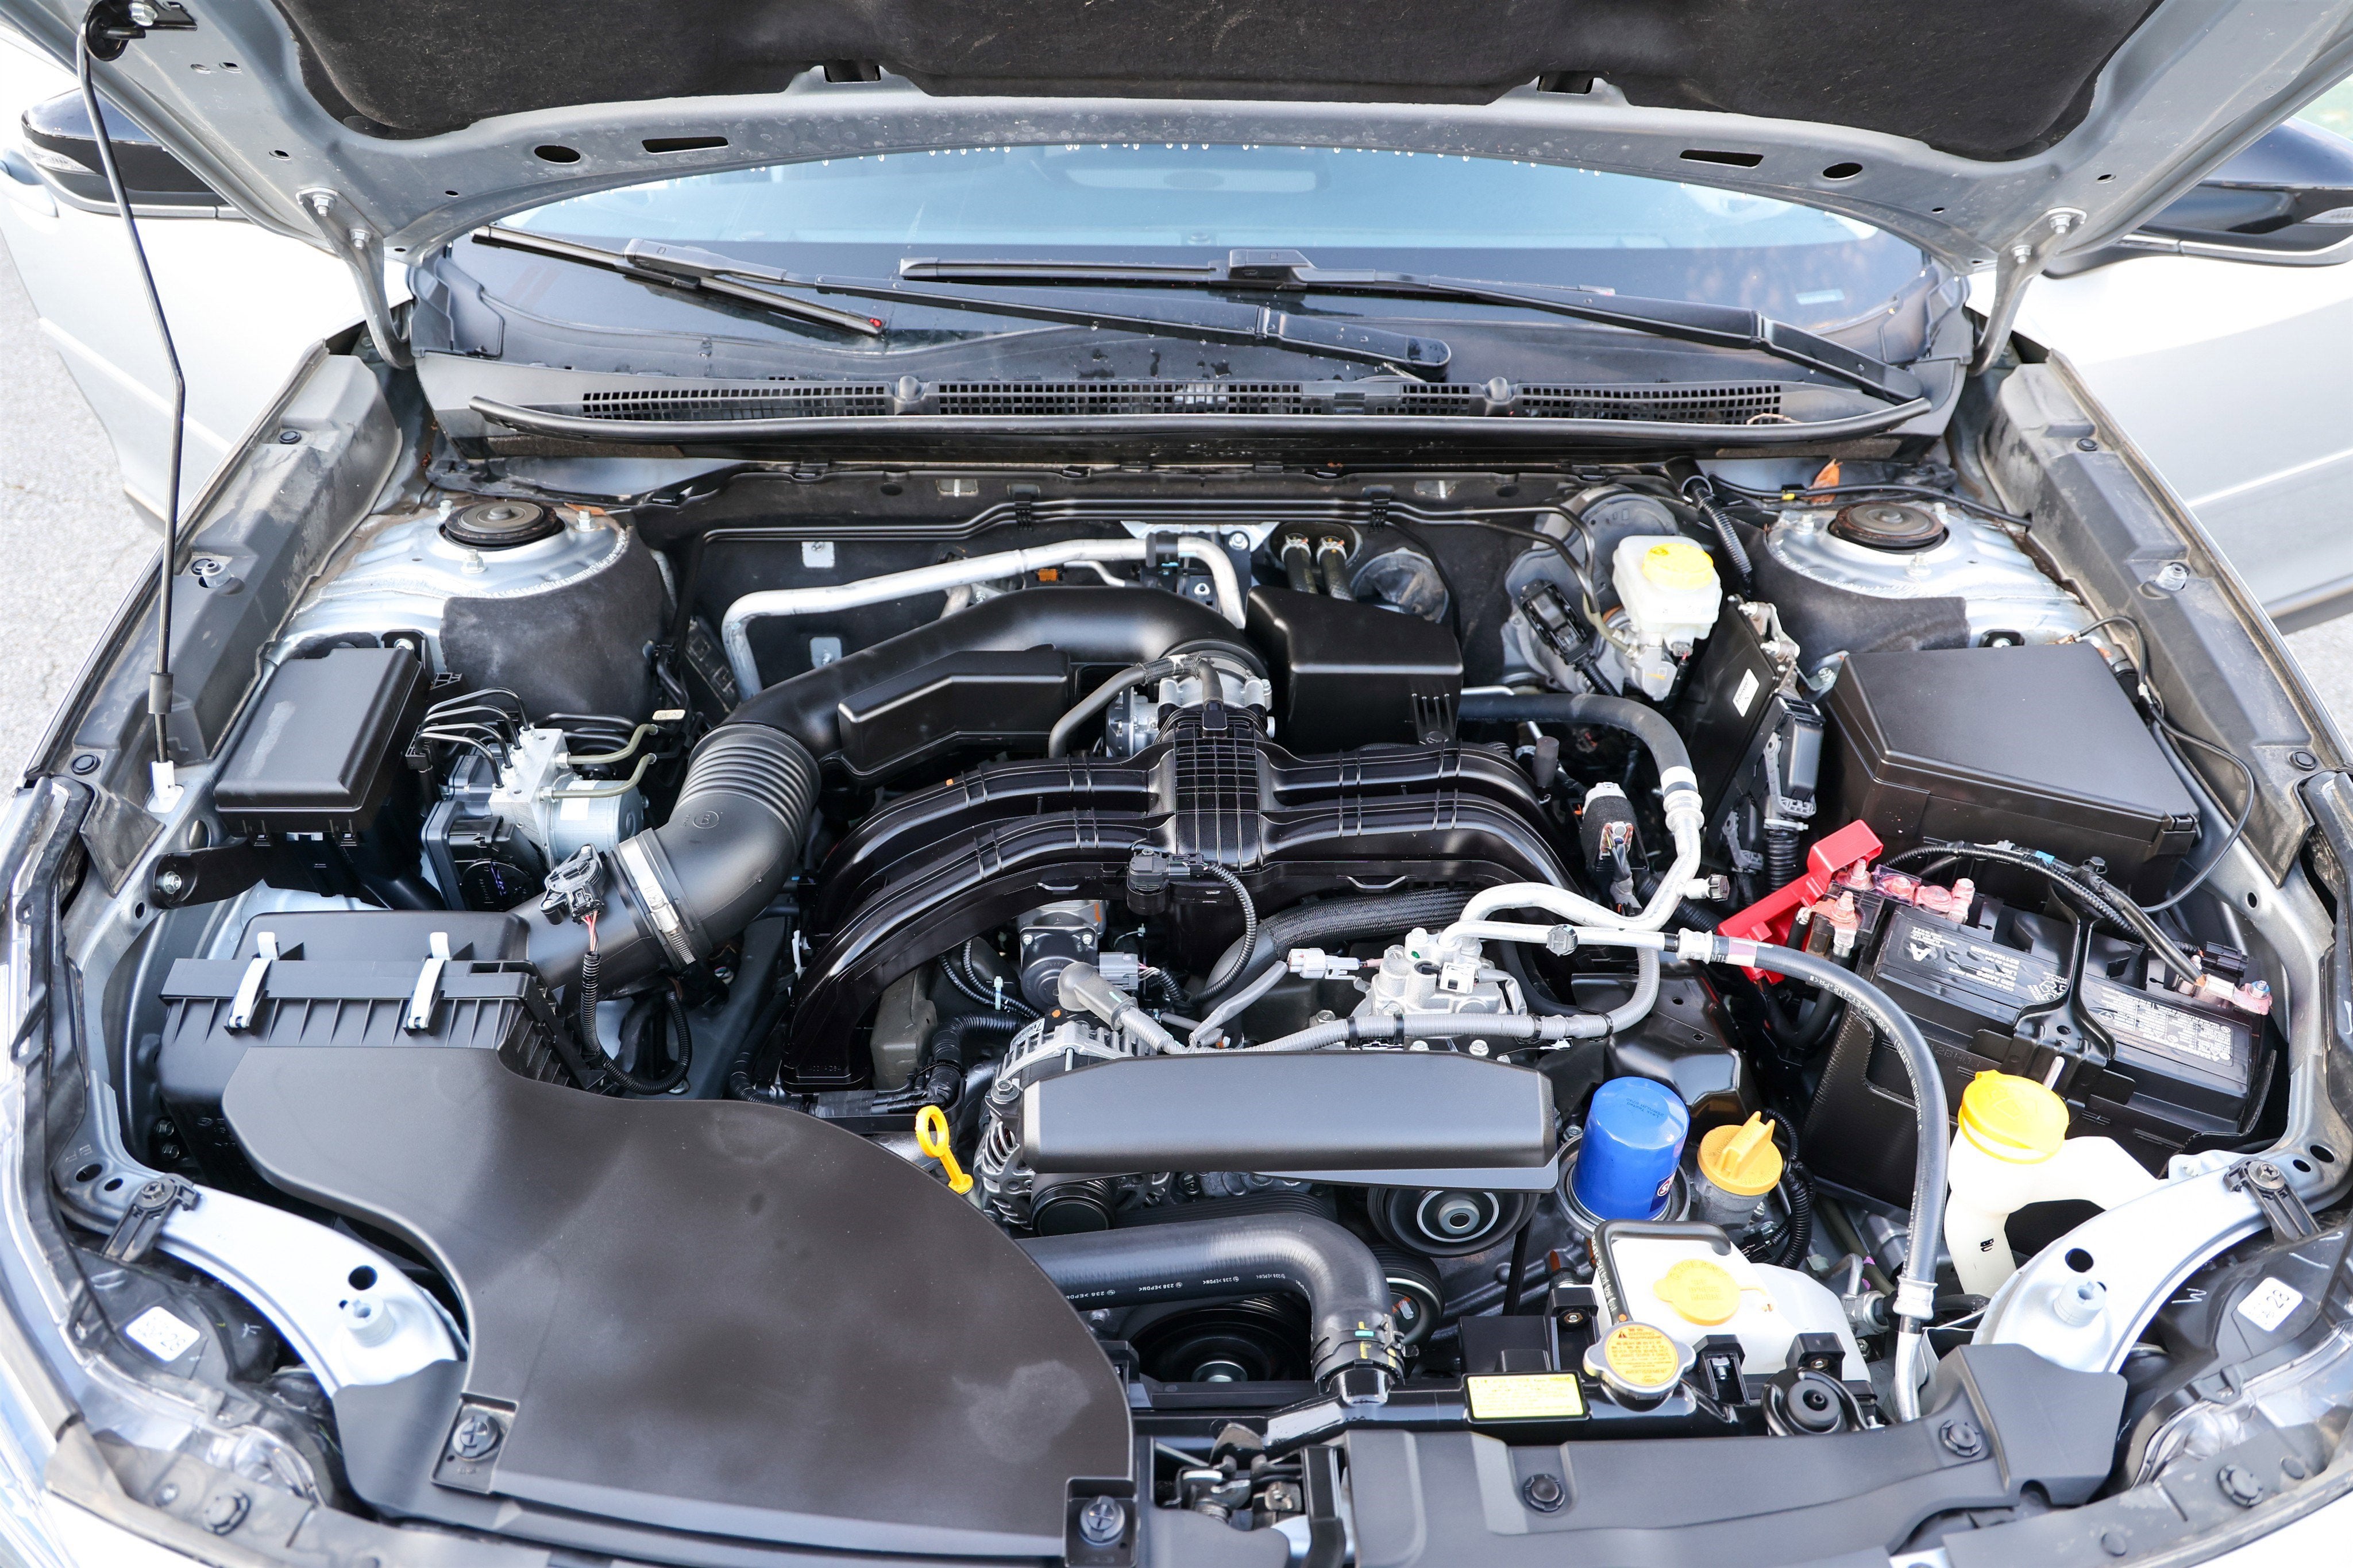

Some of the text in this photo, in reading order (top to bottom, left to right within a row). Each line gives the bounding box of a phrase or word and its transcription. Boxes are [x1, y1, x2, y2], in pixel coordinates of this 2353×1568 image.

[1551, 933, 1567, 950] H
[1909, 943, 1931, 961] A
[1975, 970, 2000, 982] AMPS
[1996, 982, 2014, 992] COLD
[2266, 1289, 2290, 1308] 28
